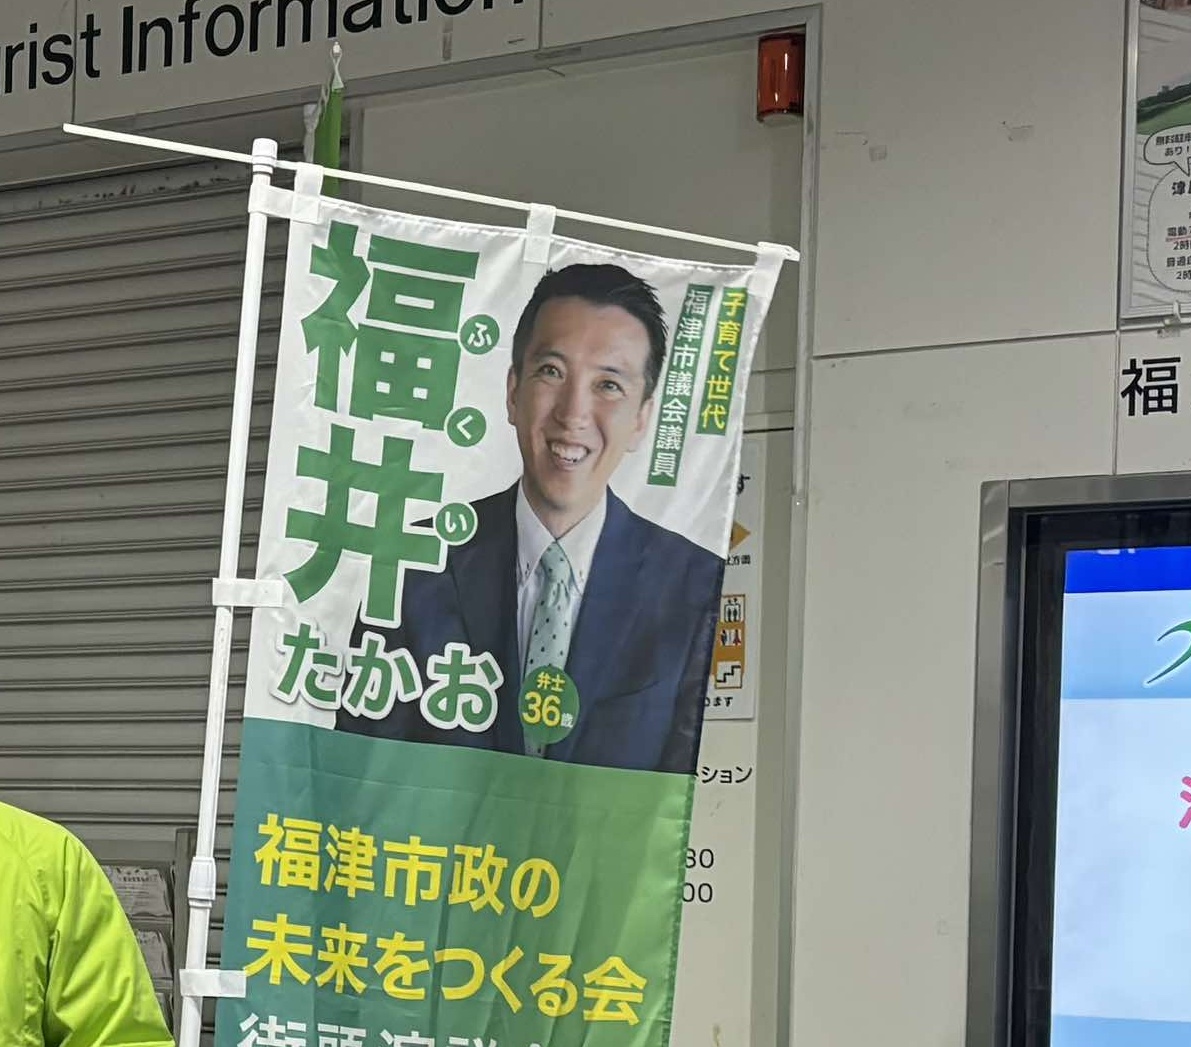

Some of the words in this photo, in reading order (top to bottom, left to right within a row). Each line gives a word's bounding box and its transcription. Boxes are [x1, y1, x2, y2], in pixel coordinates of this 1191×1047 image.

[121, 0, 524, 74] Informa
[651, 288, 711, 479] 福津市議会議員
[701, 291, 746, 431] 子育て世代
[1121, 357, 1181, 416] 福
[283, 219, 480, 621] 福井
[276, 622, 499, 727] たかお
[522, 691, 574, 728] 36歳
[537, 671, 565, 692] 弁士
[254, 813, 561, 919] 福津市政の
[242, 913, 648, 1026] 未来をつくる会
